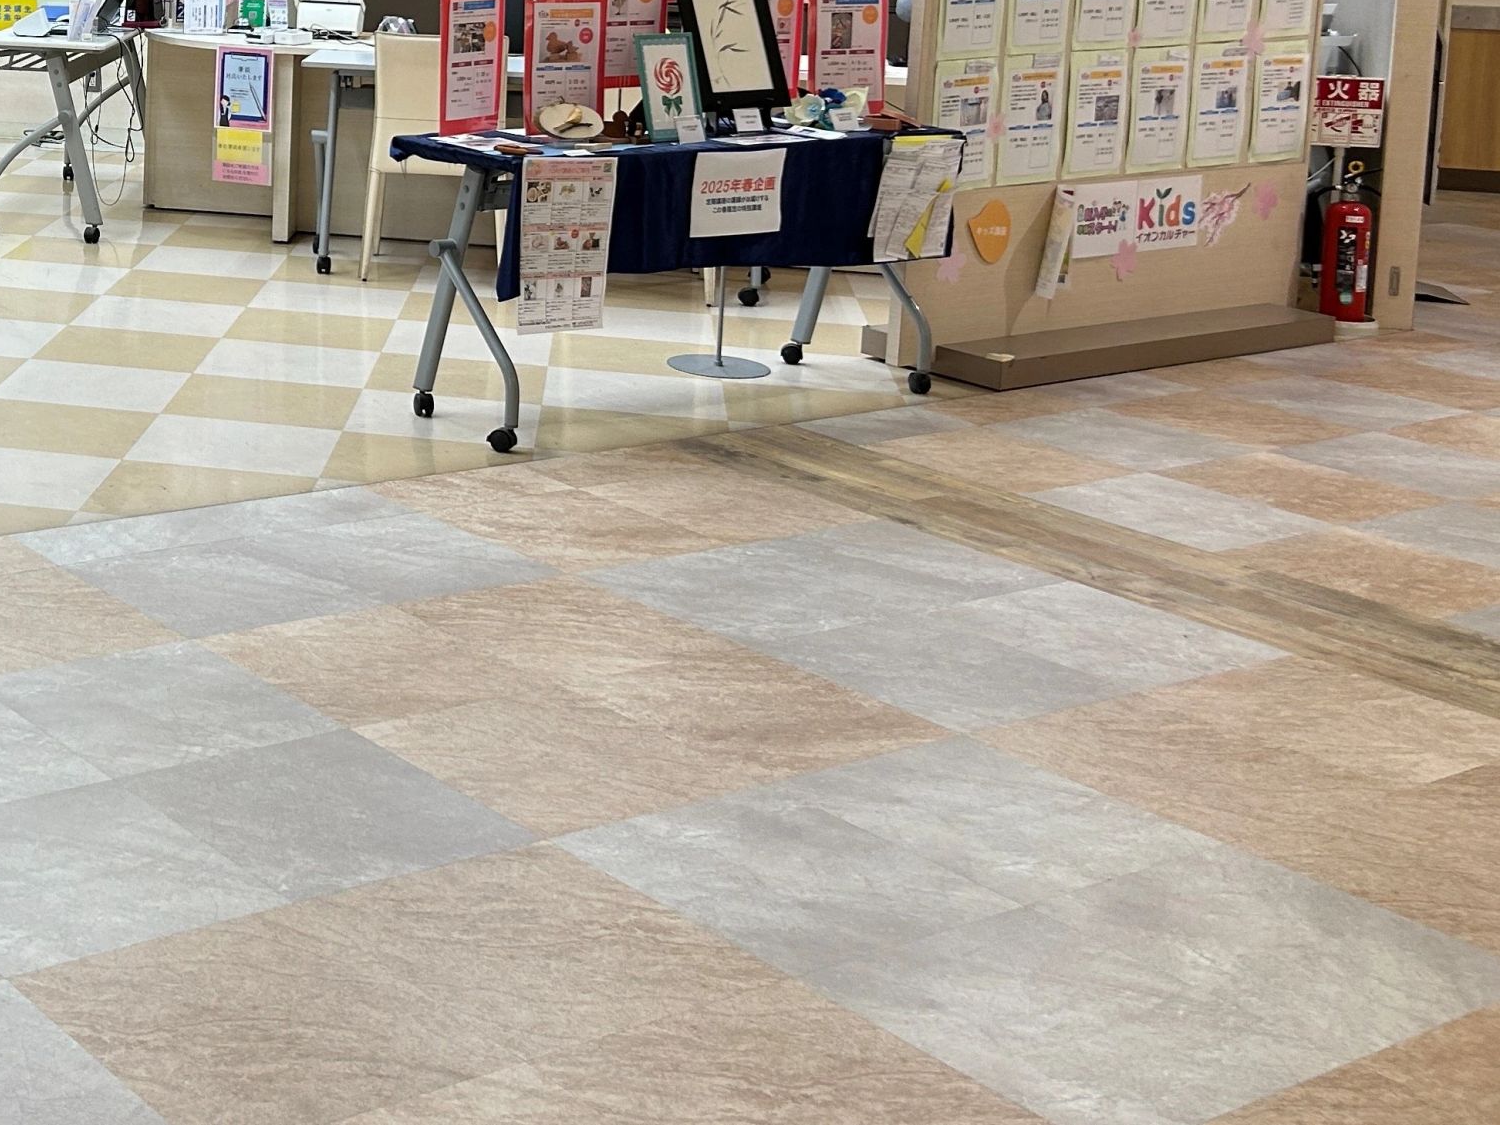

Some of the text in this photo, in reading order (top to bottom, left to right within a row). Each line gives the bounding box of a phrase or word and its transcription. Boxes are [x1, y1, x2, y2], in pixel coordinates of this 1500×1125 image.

[1316, 81, 1380, 102] 火器
[700, 176, 776, 195] 2025年春企画
[1137, 187, 1196, 230] Kids
